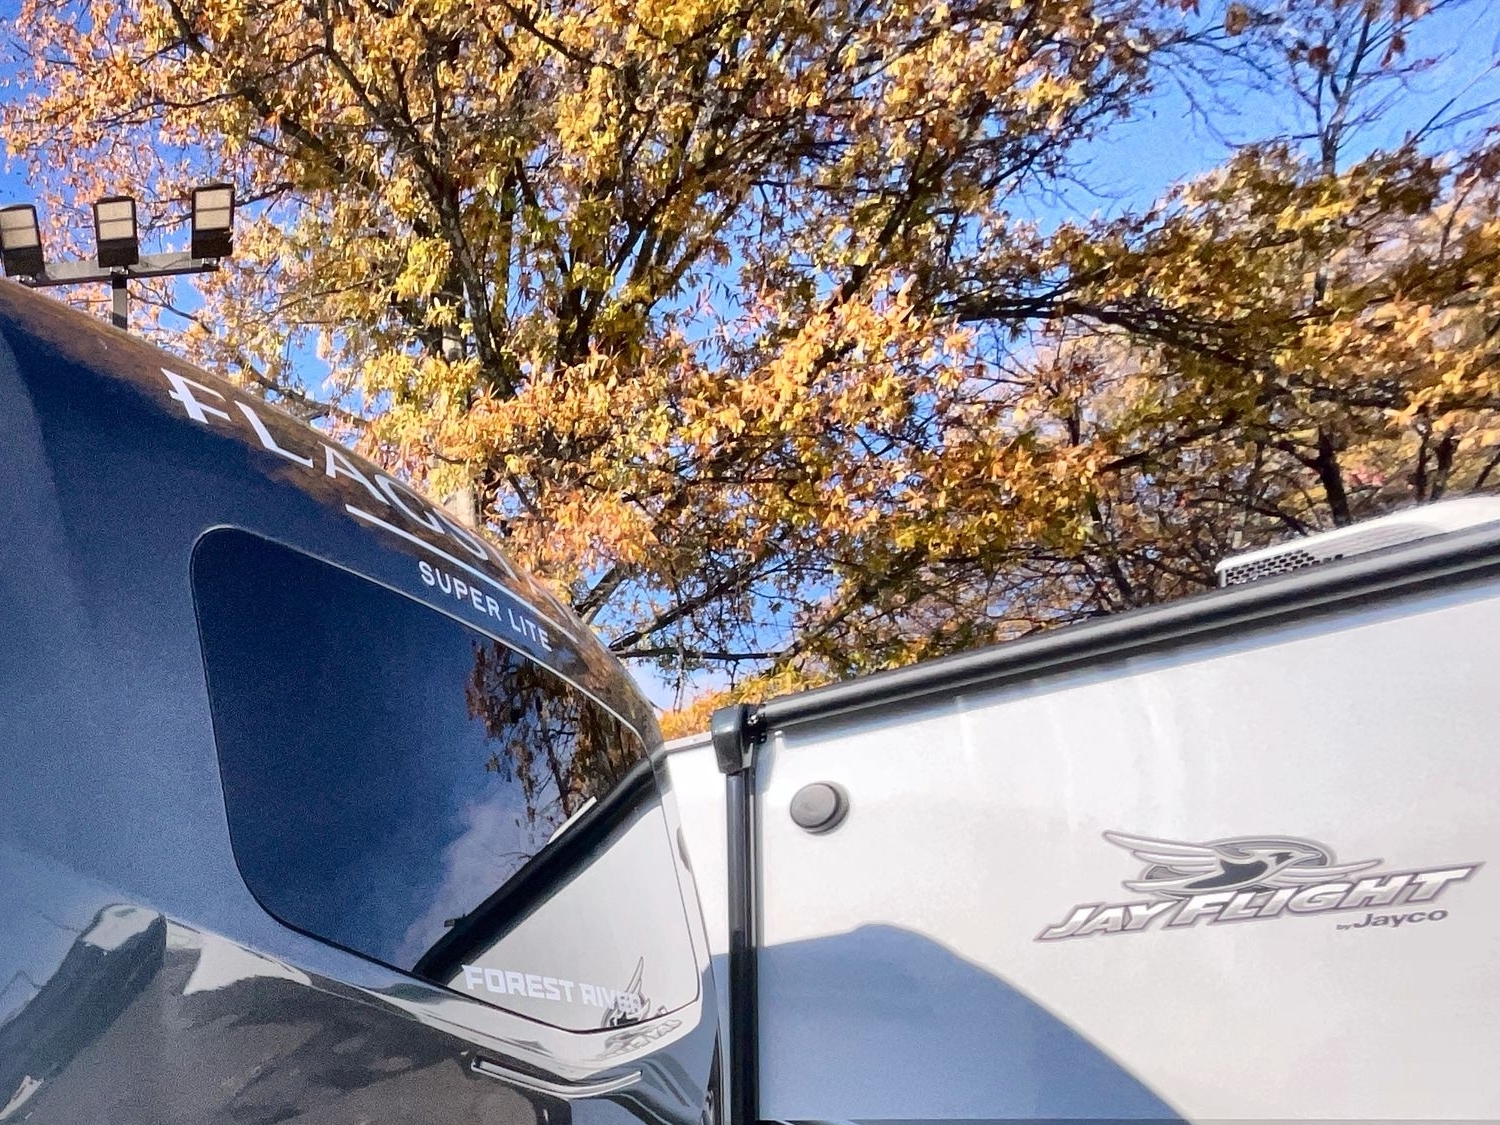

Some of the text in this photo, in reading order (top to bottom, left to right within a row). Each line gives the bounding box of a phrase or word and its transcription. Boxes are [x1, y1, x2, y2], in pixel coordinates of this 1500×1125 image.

[418, 561, 553, 652] SUPER LITE
[1033, 861, 1487, 943] JAY FLIGHT
[1353, 909, 1449, 928] Jayco
[461, 964, 642, 1015] FOREST RIVER
